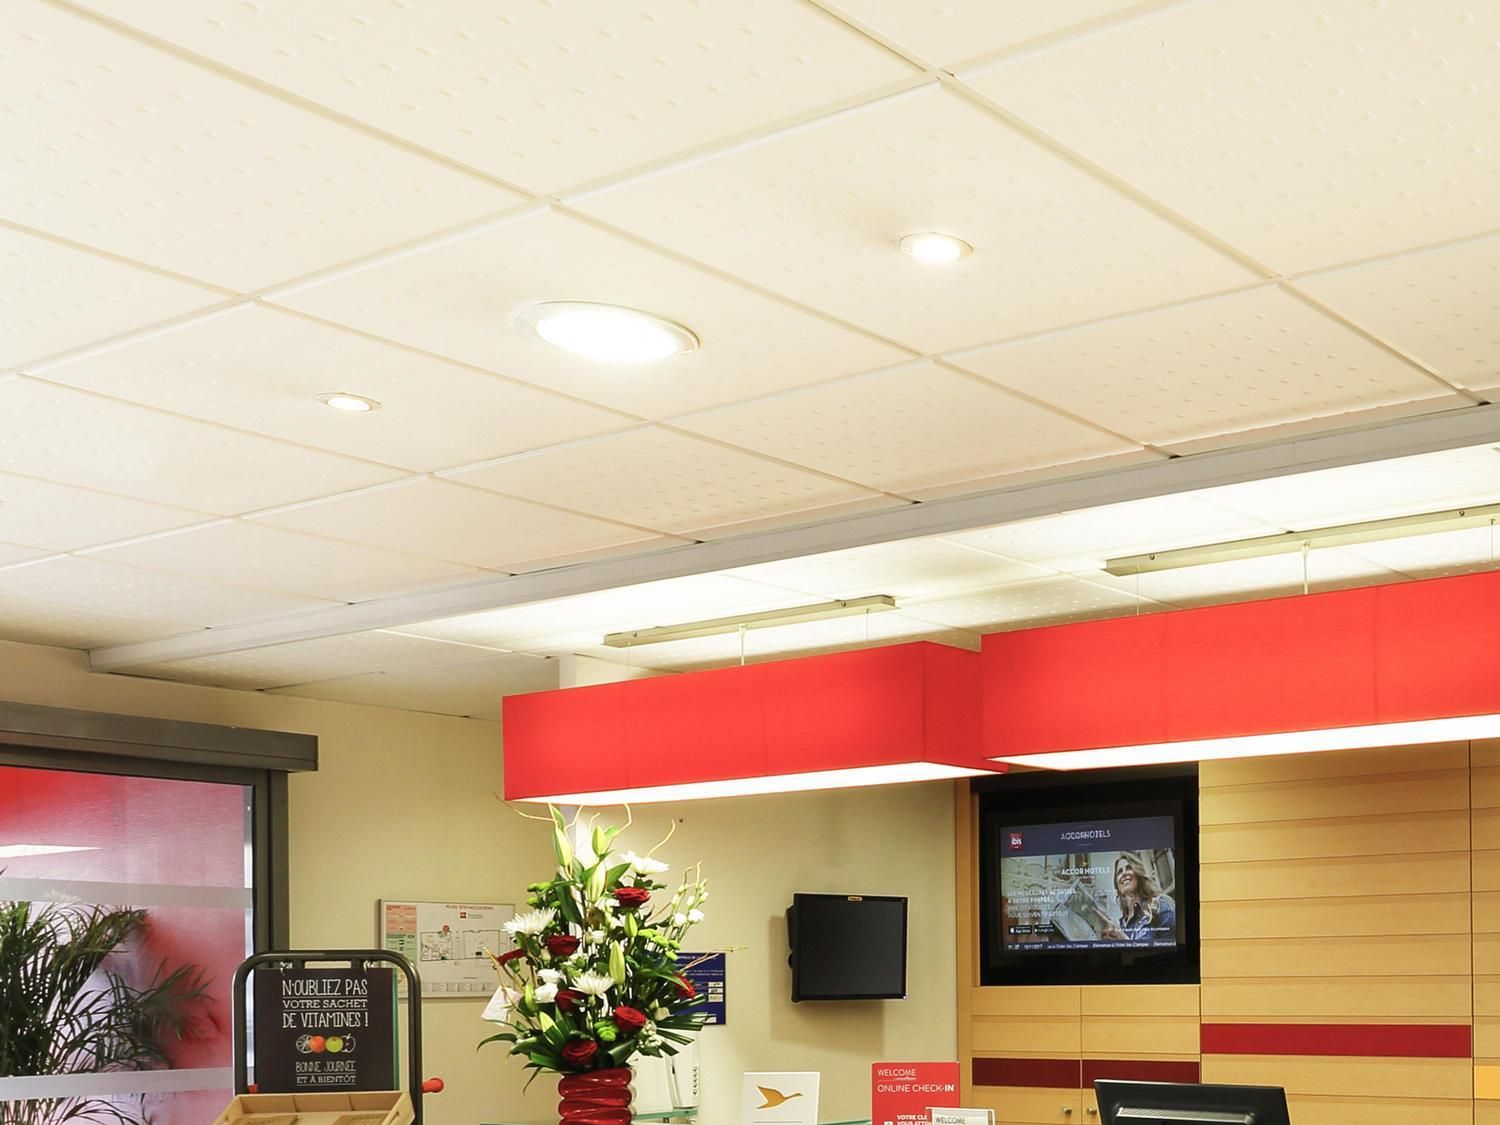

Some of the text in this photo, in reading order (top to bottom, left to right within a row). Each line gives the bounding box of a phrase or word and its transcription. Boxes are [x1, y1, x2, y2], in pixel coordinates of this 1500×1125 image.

[282, 979, 368, 996] N'OUBLIEZ PAS
[282, 1000, 368, 1009] VOTRE SACHET
[282, 1013, 296, 1028] DE
[301, 1012, 361, 1028] VITAMINES
[296, 1060, 357, 1072] BONNE JOURNÉE
[878, 1069, 916, 1077] WELCOME
[296, 1076, 308, 1084] ET
[318, 1075, 357, 1083] BIENTÔT
[877, 1084, 955, 1093] ONLINE CHECK-IN
[936, 1116, 966, 1125] WELCOME
